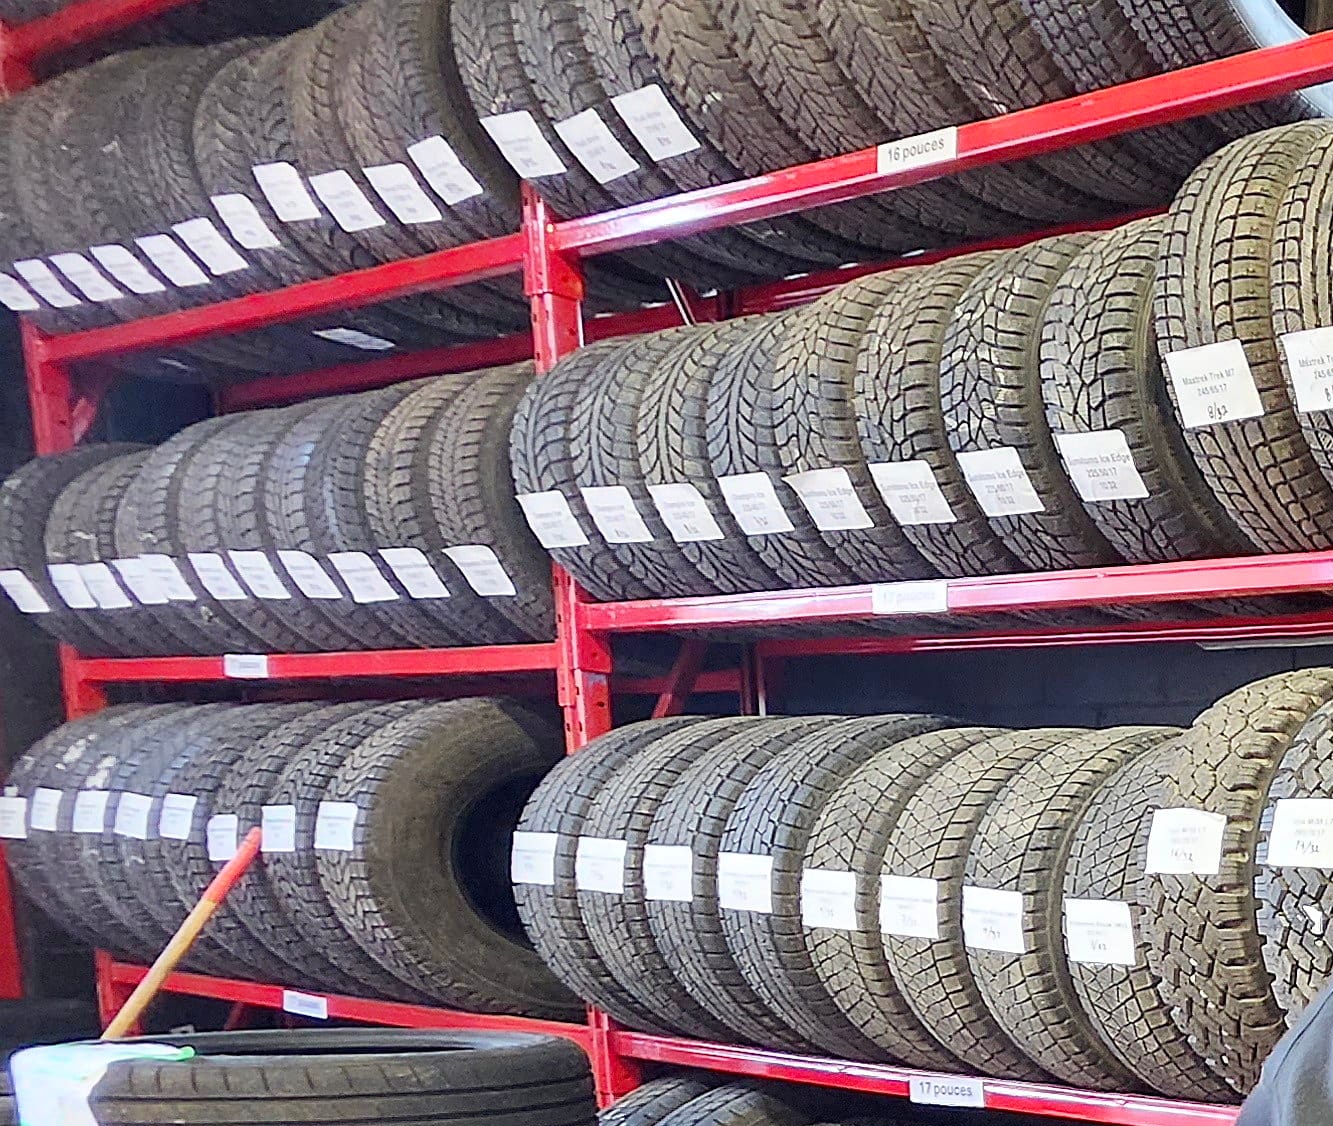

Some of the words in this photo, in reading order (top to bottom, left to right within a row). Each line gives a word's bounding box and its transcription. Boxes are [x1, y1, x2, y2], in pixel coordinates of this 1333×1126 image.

[888, 146, 900, 163] 16
[902, 138, 944, 162] pouces
[919, 1081, 931, 1094] 17
[933, 1084, 973, 1098] pouces
